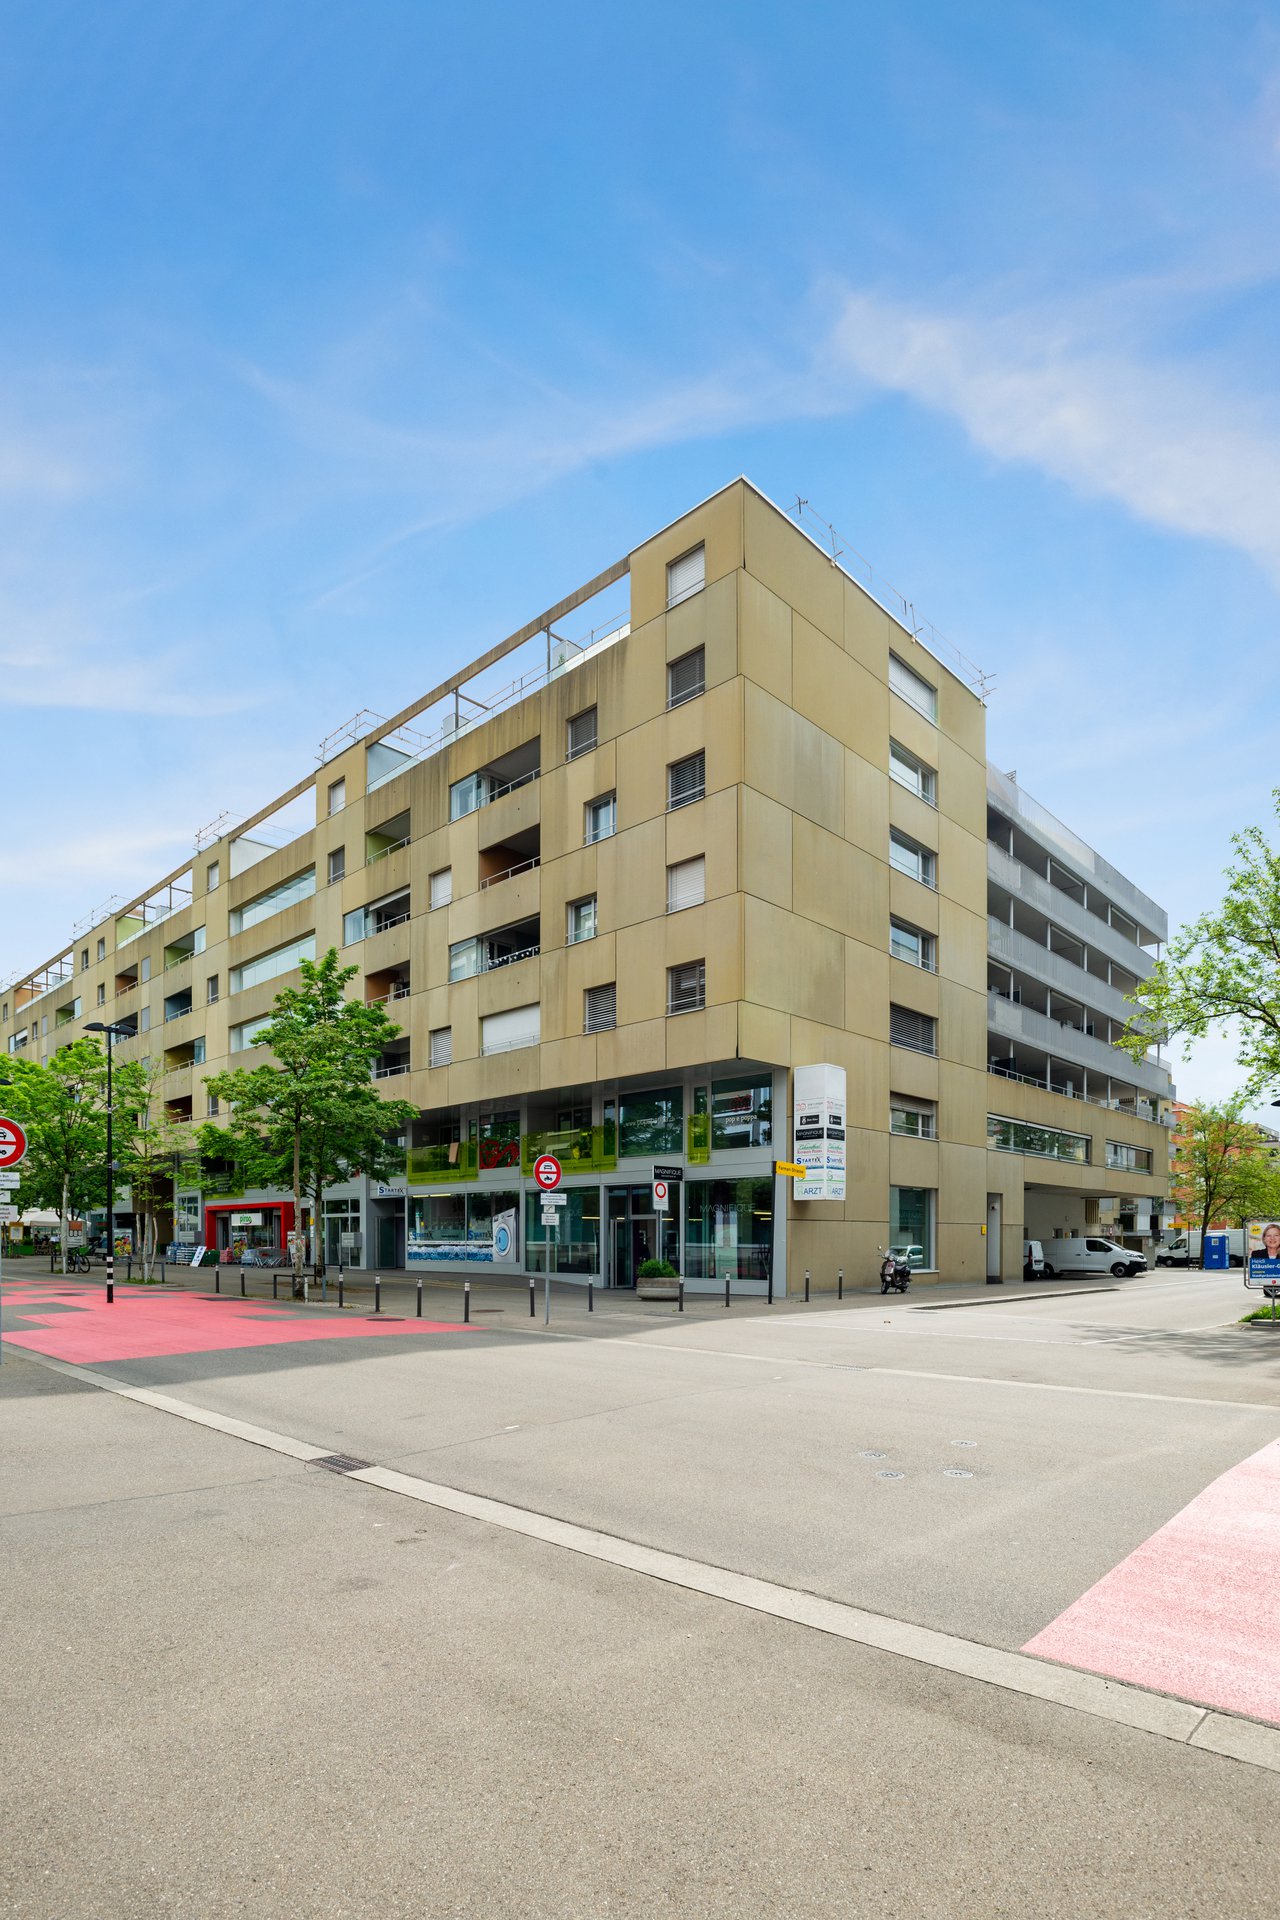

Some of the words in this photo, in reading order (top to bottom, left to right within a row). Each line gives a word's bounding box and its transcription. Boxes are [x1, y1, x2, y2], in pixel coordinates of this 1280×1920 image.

[725, 1116, 736, 1125] pop
[654, 1168, 682, 1176] MAGNIFIQUE
[803, 1187, 823, 1195] ARZT
[831, 1187, 844, 1195] ARZT
[700, 1202, 757, 1212] MAGNIFIQUE
